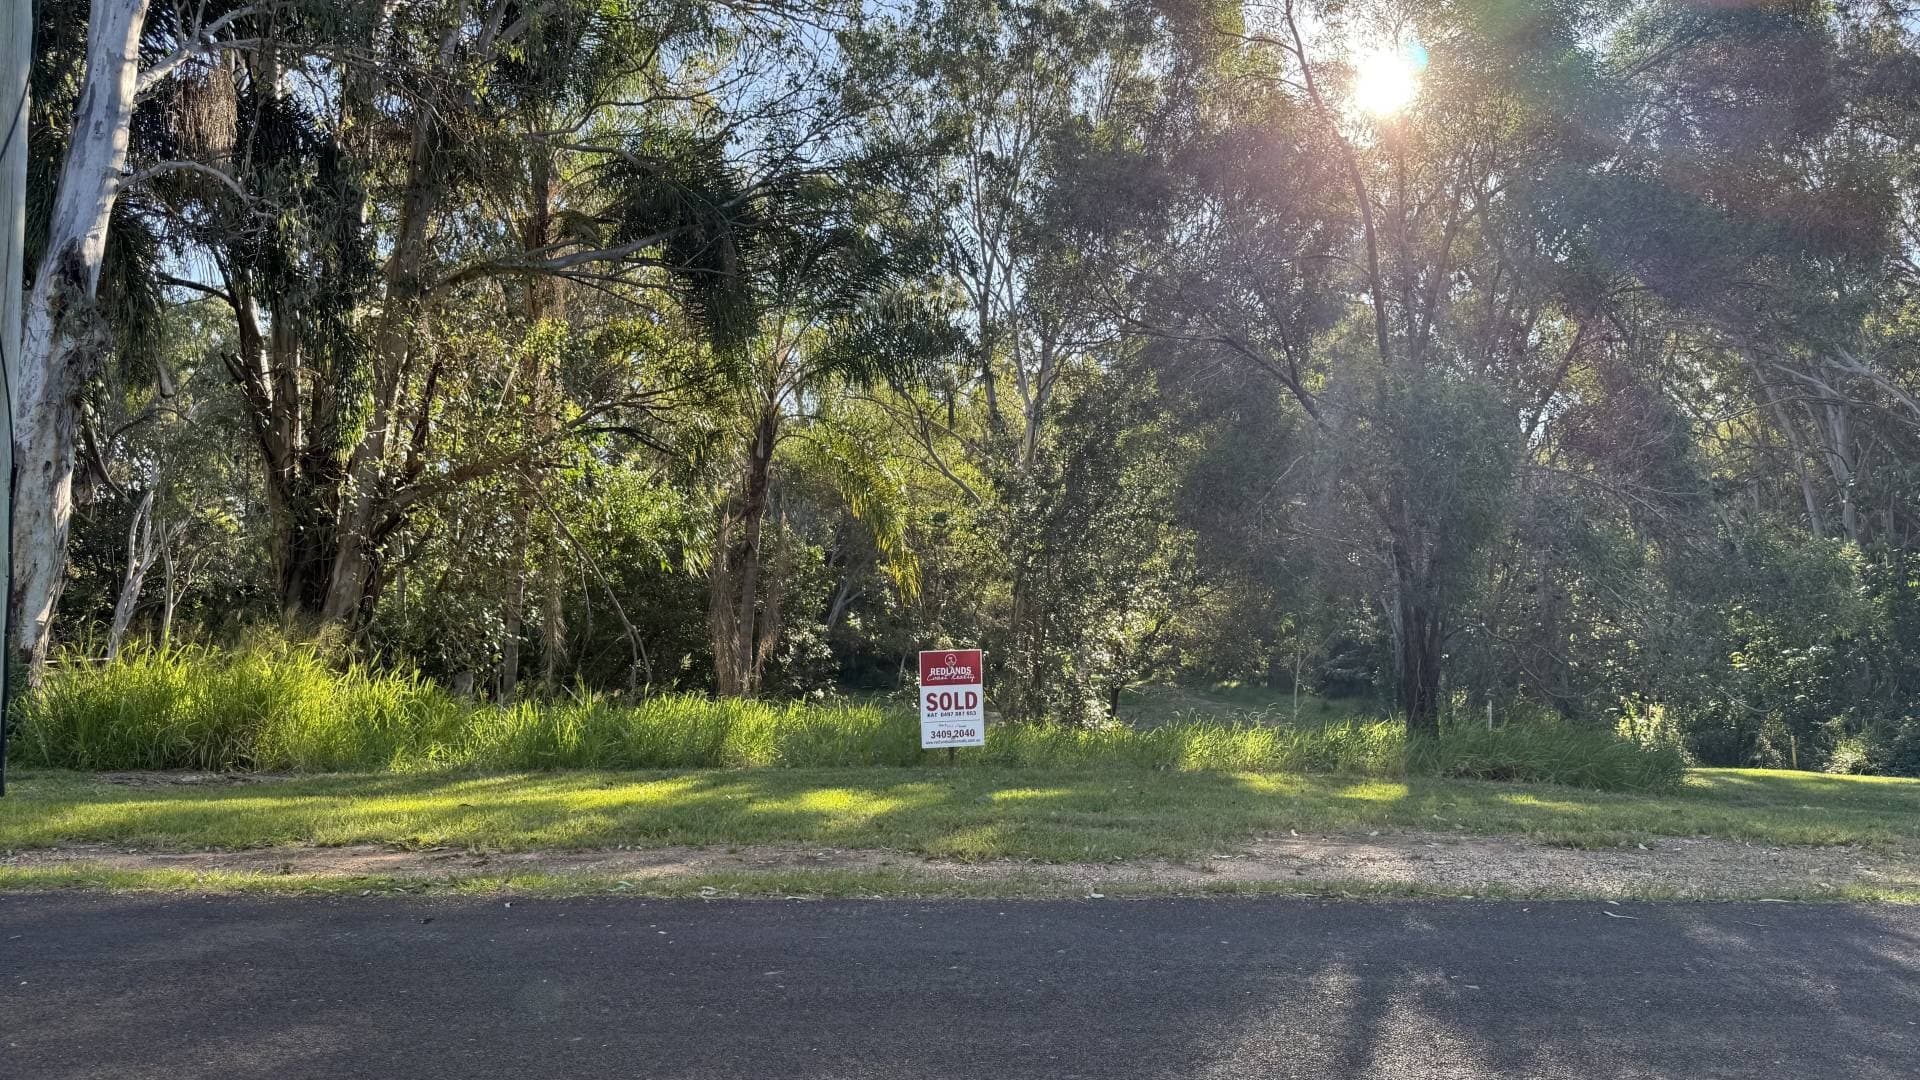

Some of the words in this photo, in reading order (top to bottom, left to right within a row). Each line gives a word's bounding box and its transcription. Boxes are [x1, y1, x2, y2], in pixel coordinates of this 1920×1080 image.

[930, 666, 972, 676] REDLANDS
[926, 692, 978, 711] SOLD
[930, 730, 952, 739] 3409
[952, 728, 975, 738] 2040
